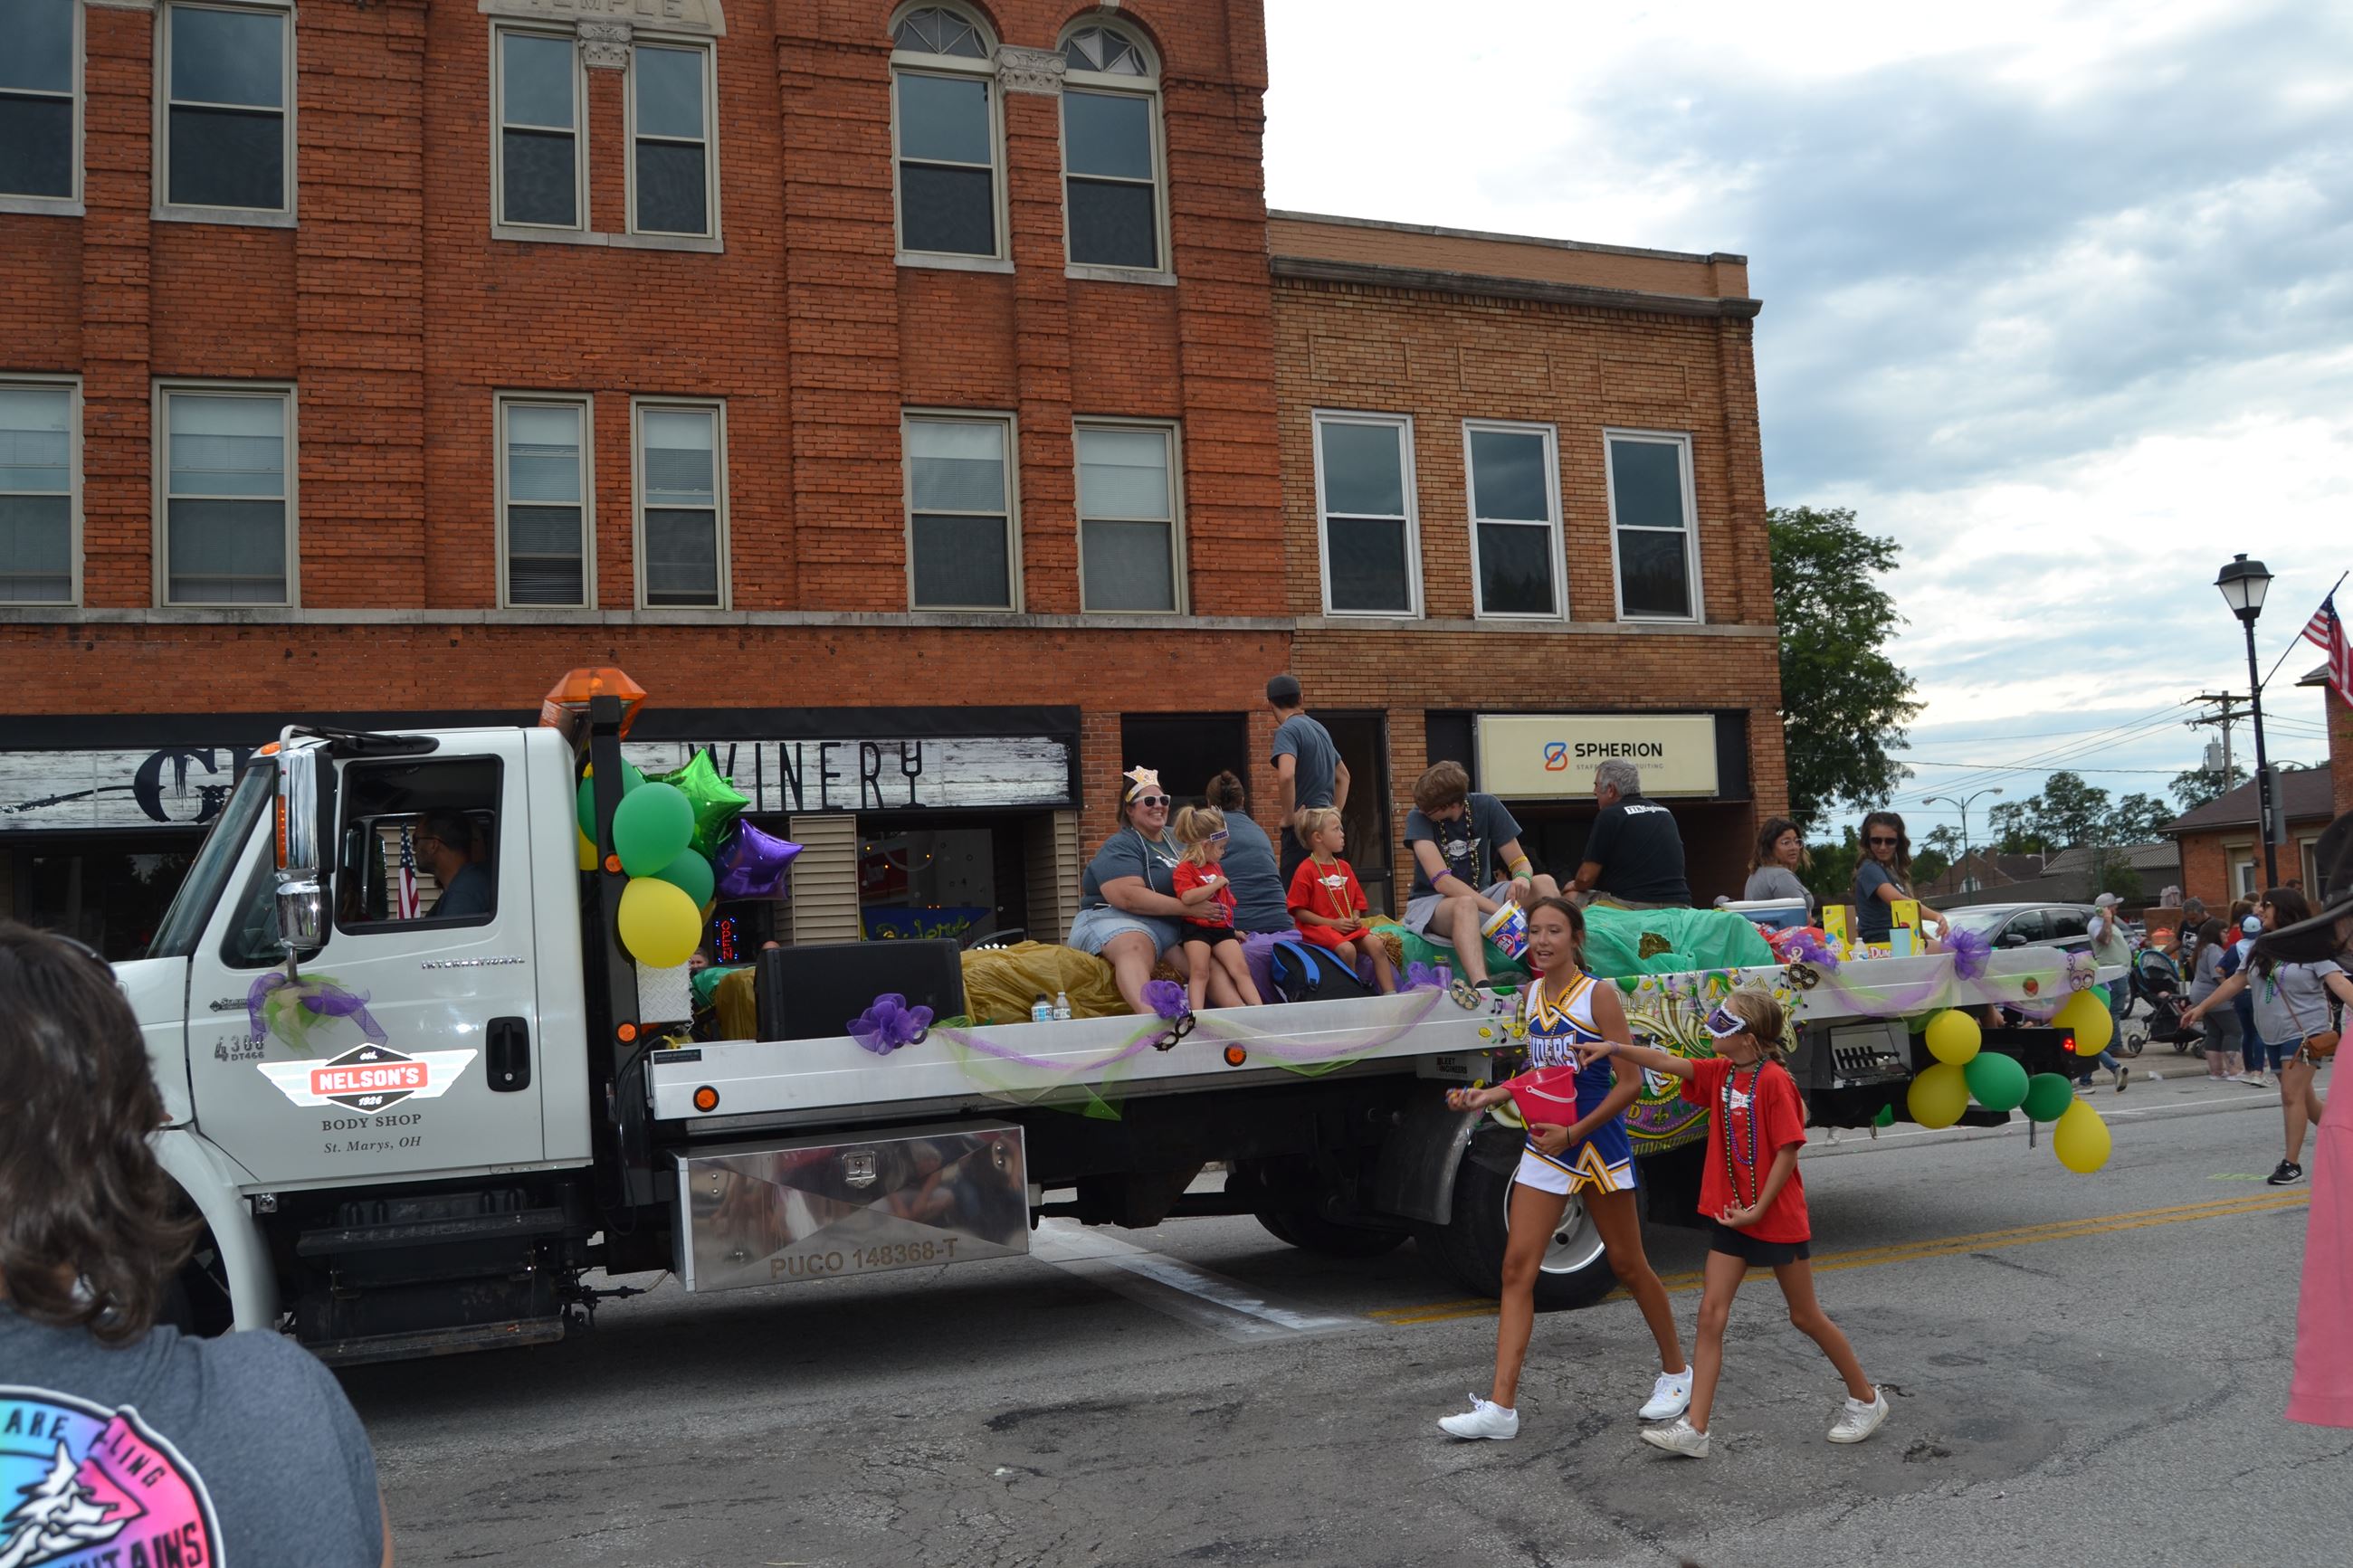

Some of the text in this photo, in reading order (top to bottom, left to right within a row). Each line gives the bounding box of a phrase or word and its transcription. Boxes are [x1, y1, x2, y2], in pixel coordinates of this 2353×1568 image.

[531, 0, 681, 18] MPLE
[1575, 743, 1662, 757] SPHERION
[214, 1034, 264, 1061] 4300
[231, 1051, 265, 1061] DT466
[1529, 1033, 1579, 1072] IDERS
[319, 1067, 420, 1091] NELSON'S
[358, 1096, 383, 1106] 1926
[321, 1114, 422, 1131] BODY SHOP
[324, 1136, 423, 1154] St. Marys, OH
[770, 1237, 958, 1279] PUCO 148368-T
[4, 1408, 70, 1440] ARE
